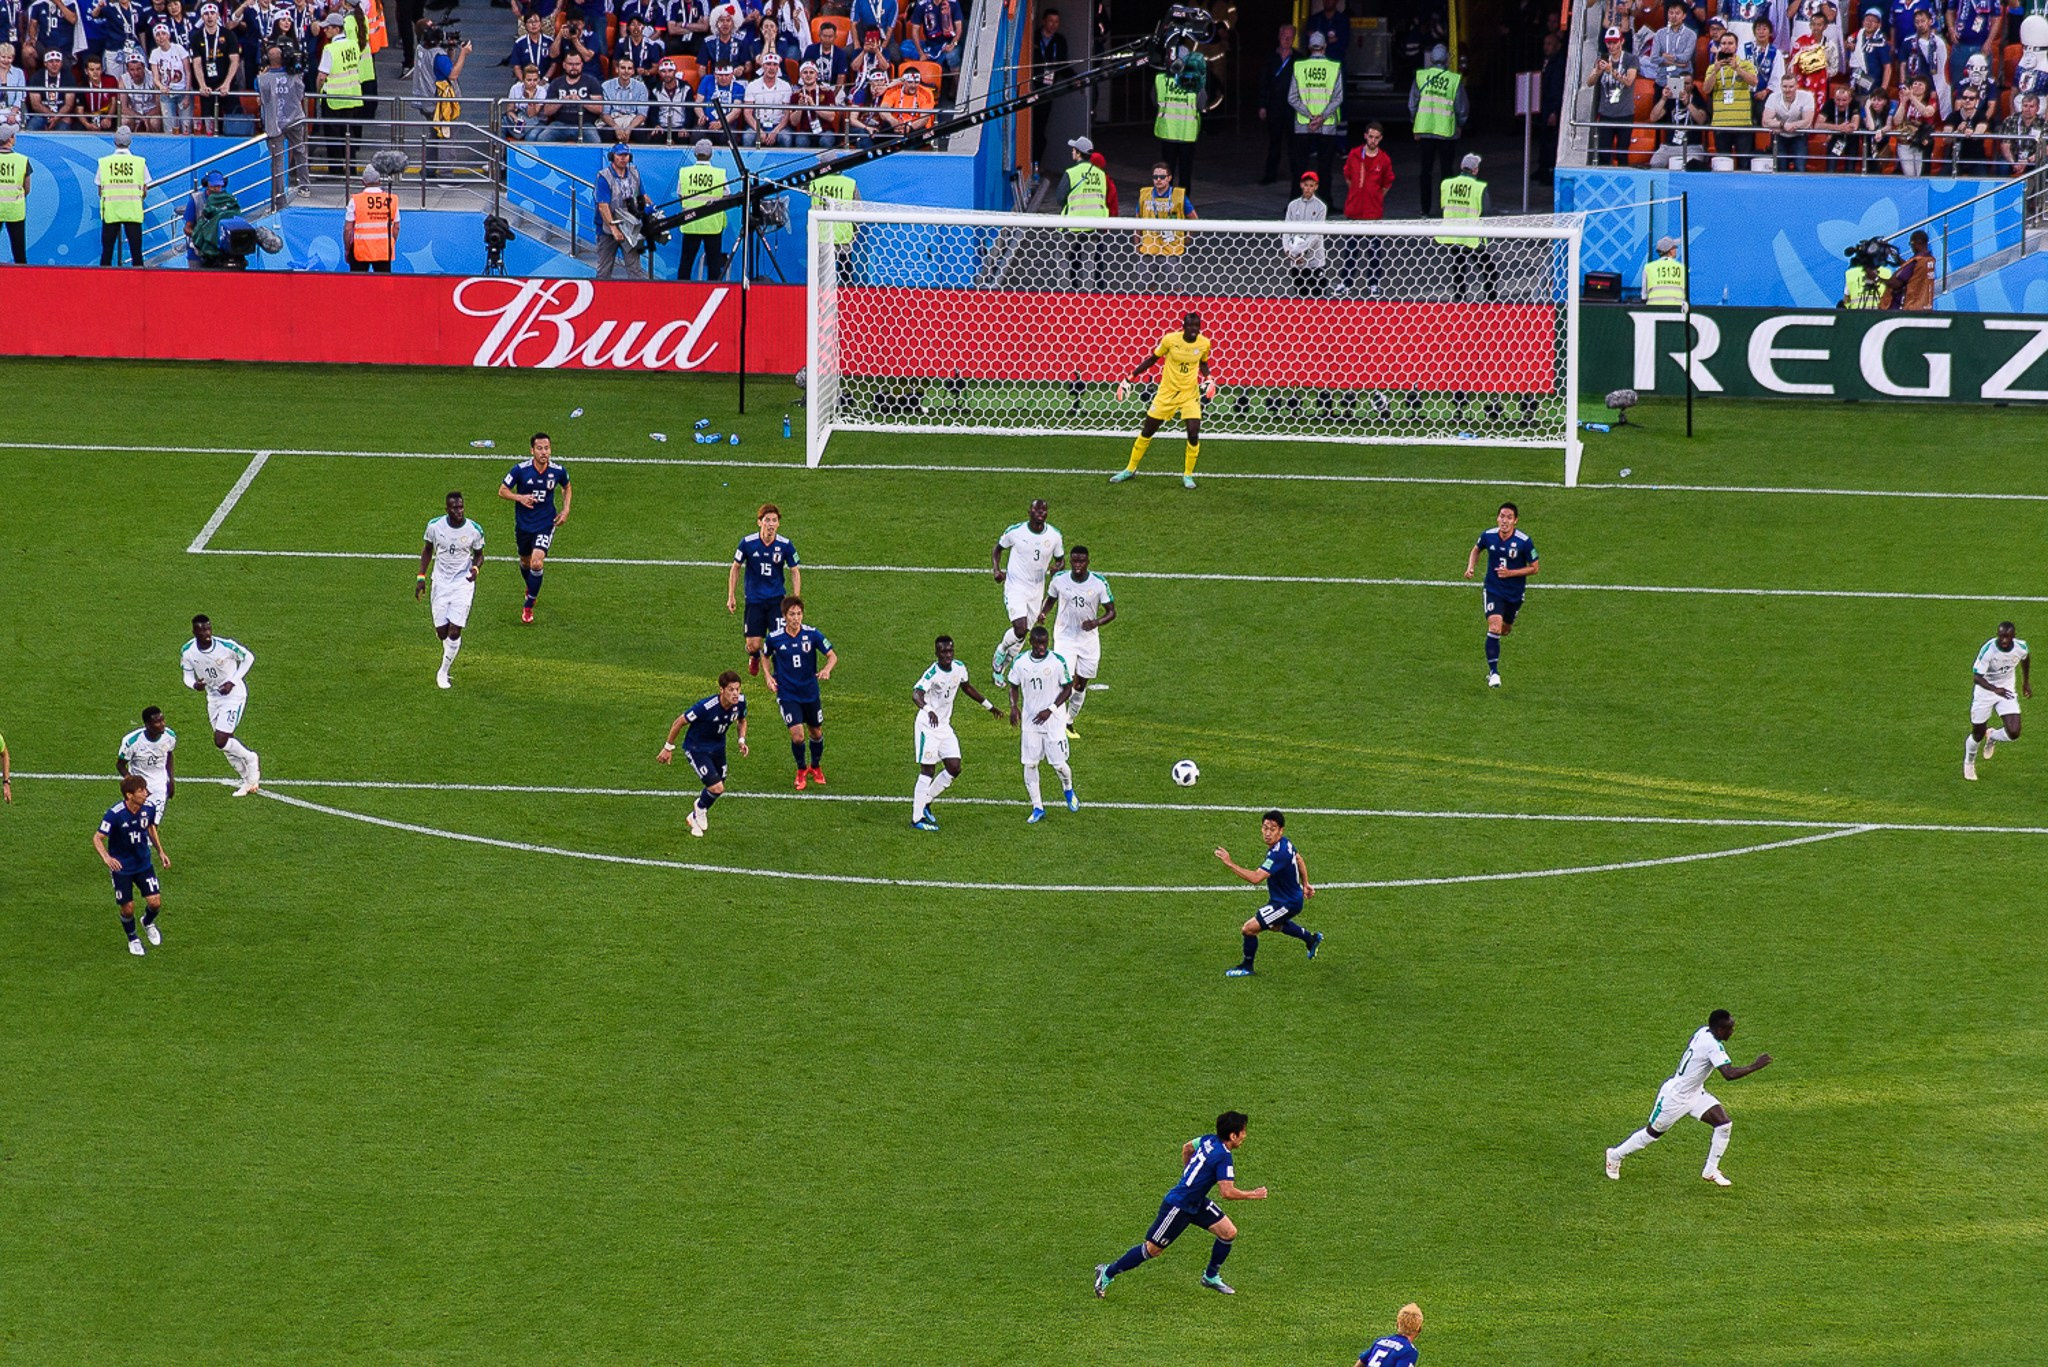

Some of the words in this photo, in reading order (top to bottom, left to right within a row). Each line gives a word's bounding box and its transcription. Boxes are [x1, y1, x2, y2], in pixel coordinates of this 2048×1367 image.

[0, 163, 15, 176] 611
[453, 277, 729, 369] Bud
[1628, 311, 2048, 398] REGZ
[532, 490, 546, 502] 22
[535, 534, 550, 549] 22
[1033, 549, 1040, 561] 3
[760, 562, 772, 577] 15
[1072, 596, 1085, 608] 13
[793, 654, 802, 668] 8
[205, 667, 218, 679] 19
[129, 831, 141, 844] 14
[145, 877, 160, 892] 14
[1183, 1146, 1206, 1187] 17
